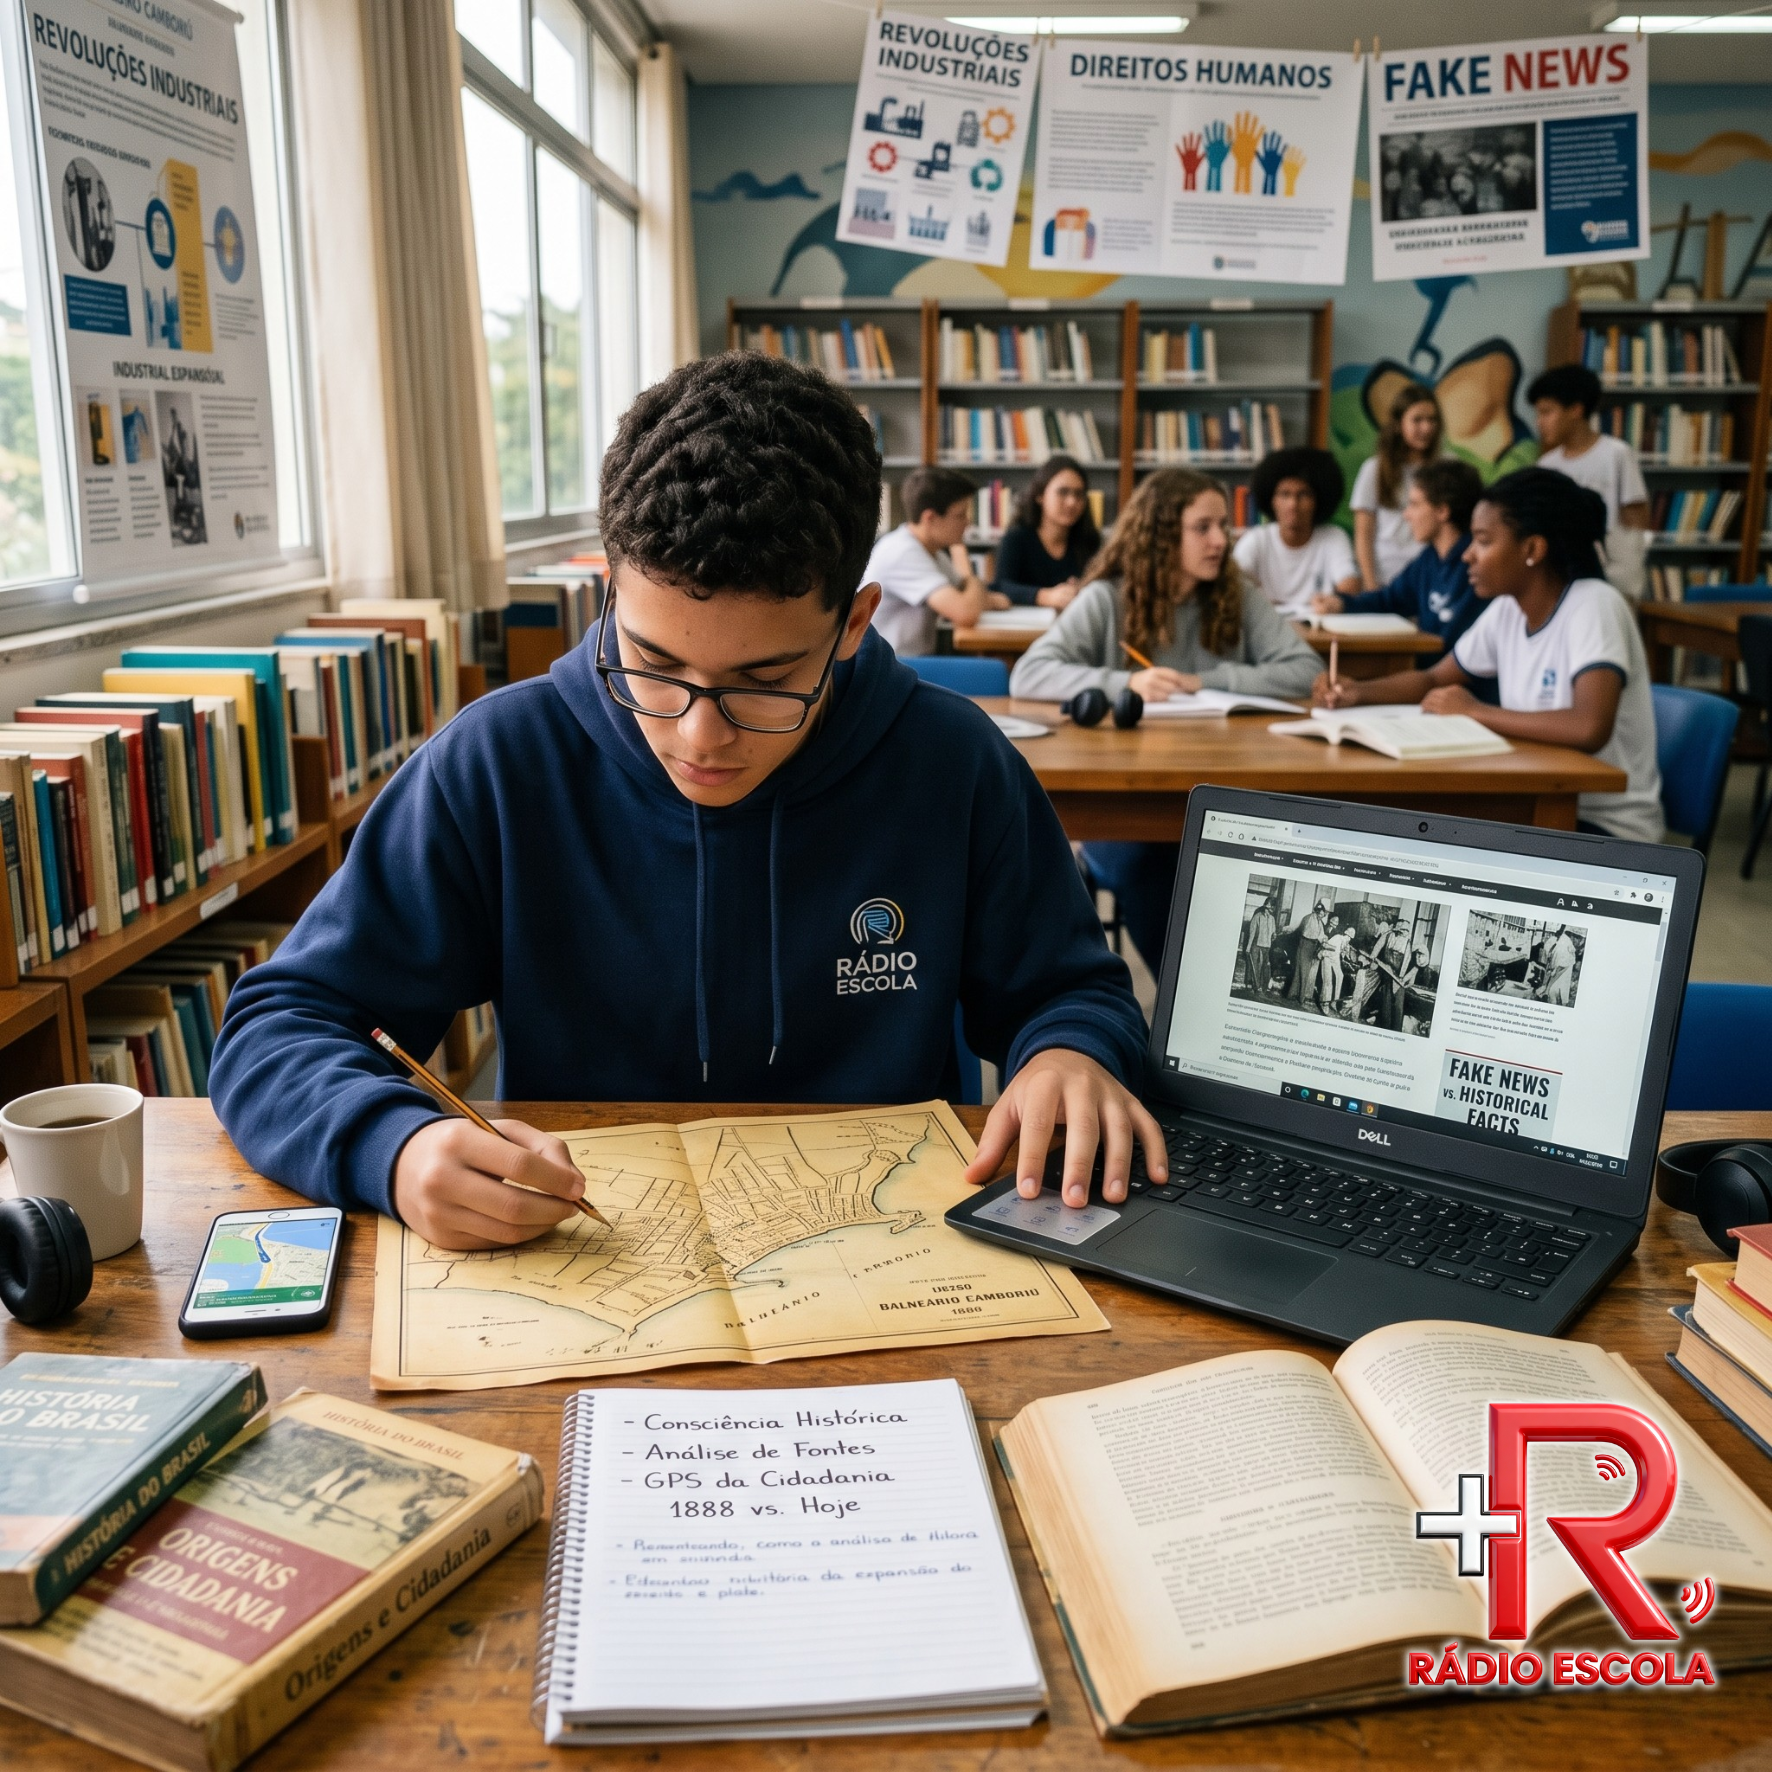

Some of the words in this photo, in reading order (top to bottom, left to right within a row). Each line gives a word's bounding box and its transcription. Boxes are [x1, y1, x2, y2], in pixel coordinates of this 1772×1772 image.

[880, 21, 1029, 63] REVOLUÇÕES
[34, 13, 147, 86] REVOLUÇÕES
[150, 65, 239, 124] INDUSTRIAIS
[878, 48, 1021, 88] INDUSTRIAIS
[1070, 54, 1188, 82] DIREITOS
[1196, 60, 1332, 89] HUMANOS
[1384, 56, 1491, 102] FAKE
[1504, 43, 1630, 93] NEWS
[112, 361, 170, 380] INDUSTRIAL
[836, 949, 917, 978] RÁDIO
[836, 973, 918, 996] ESCOLA
[1449, 1057, 1495, 1087] FAKE
[1499, 1068, 1550, 1098] NEWS
[1459, 1085, 1548, 1121] HISTORICAL
[1358, 1128, 1391, 1146] DELL
[1467, 1108, 1520, 1136] FACTS
[0, 1388, 140, 1412] HISTÓRIA
[25, 1410, 151, 1432] BRASIL
[322, 1411, 389, 1437] HISTÓRIA
[391, 1432, 415, 1444] DO
[414, 1439, 466, 1460] BRASIL
[644, 1413, 784, 1431] Consciência
[796, 1409, 908, 1427] Histórica
[645, 1443, 739, 1460] Análise
[752, 1443, 780, 1458] de
[793, 1440, 876, 1458] Fontes
[644, 1472, 702, 1489] GPS
[716, 1472, 750, 1488] da
[760, 1468, 896, 1487] Cidadania
[64, 1498, 137, 1575] HISTÓRIA
[138, 1477, 160, 1507] DO
[162, 1432, 211, 1485] BRASIL
[670, 1500, 734, 1518] 1888
[750, 1504, 784, 1516] vs.
[801, 1496, 861, 1519] Hoje
[159, 1527, 299, 1591] ORIGENS
[125, 1554, 288, 1633] CIDADANIA
[284, 1623, 374, 1701] Origens
[378, 1608, 391, 1628] e
[395, 1528, 491, 1613] Cidadania
